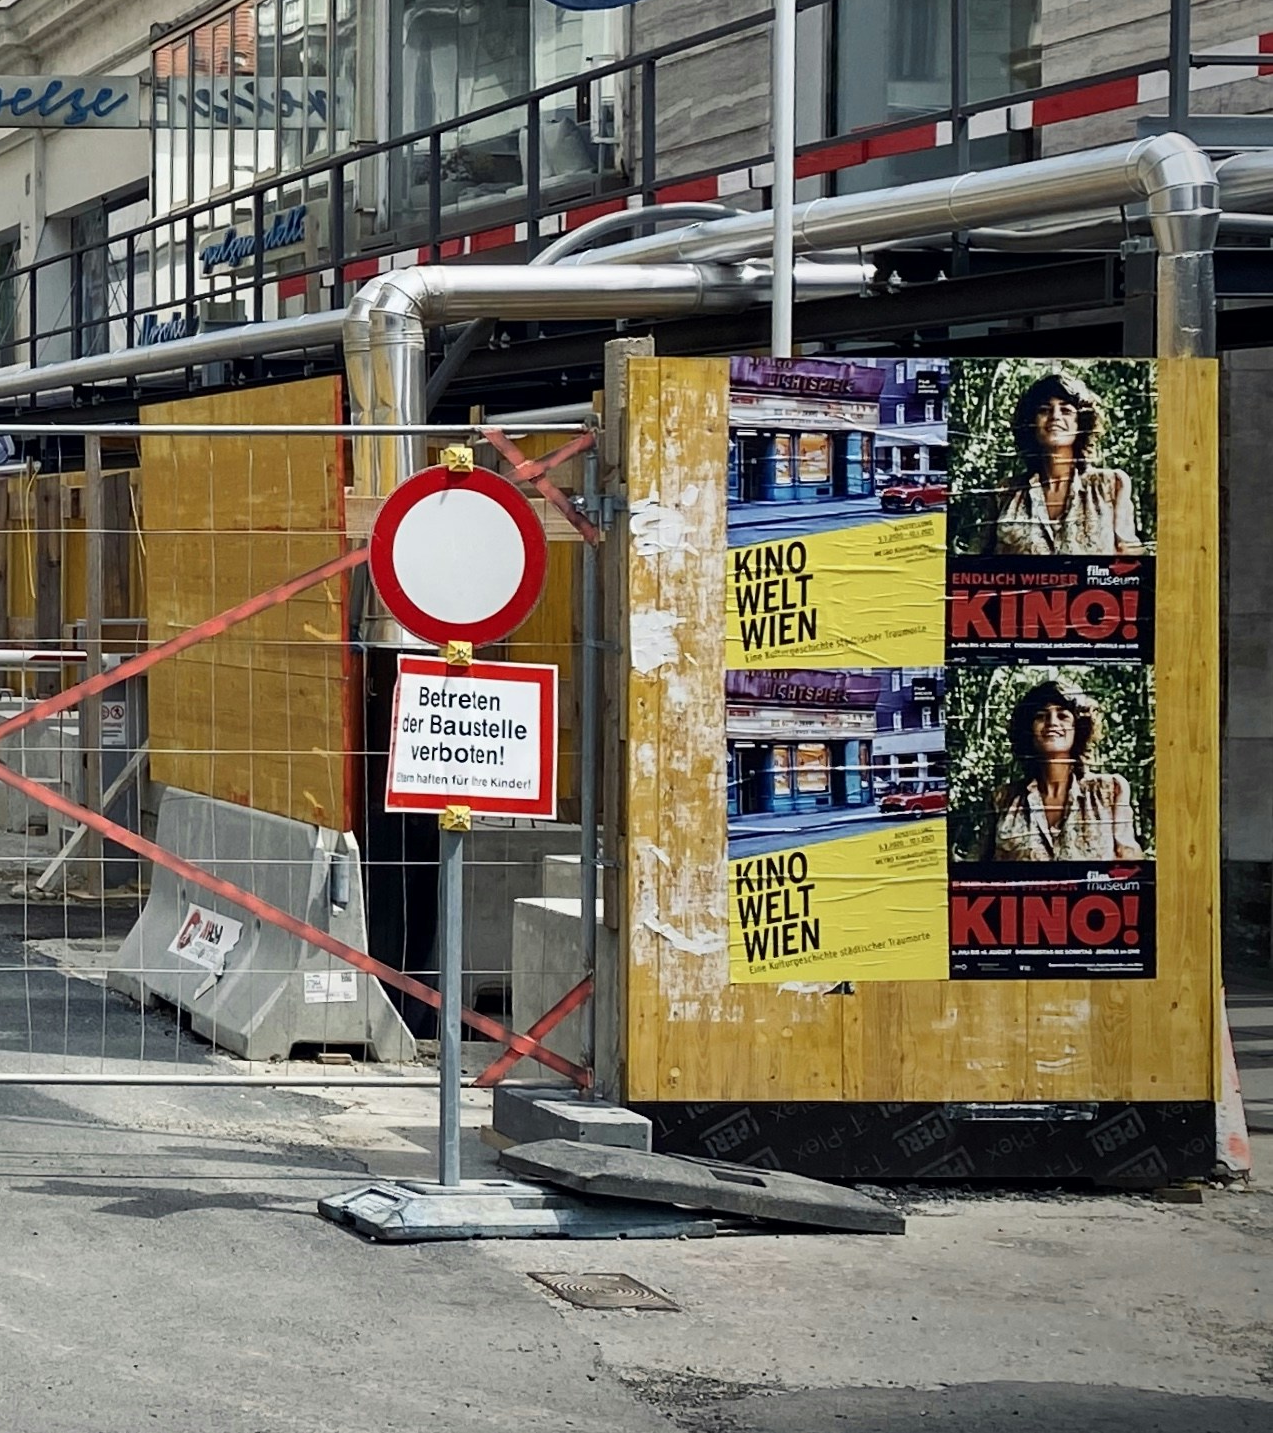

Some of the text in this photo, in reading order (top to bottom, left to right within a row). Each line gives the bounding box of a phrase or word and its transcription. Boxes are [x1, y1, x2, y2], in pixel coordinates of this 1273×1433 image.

[734, 541, 807, 583] KINO
[952, 572, 1079, 586] ENDLICH WIEDER
[1086, 576, 1140, 586] museum
[735, 574, 813, 618] WELT
[951, 588, 1140, 640] KINO!
[740, 608, 817, 652] WIEN
[419, 686, 501, 712] Betreten
[402, 713, 528, 740] der Baustelle
[411, 742, 505, 766] verboten!
[416, 773, 448, 785] haften
[452, 774, 469, 786] für
[490, 777, 531, 790] Kinder!
[735, 851, 808, 895] KINO
[1086, 881, 1140, 891] museum
[737, 883, 816, 929] WELT
[951, 895, 1140, 945] KINO!
[743, 918, 820, 963] WIEN
[749, 962, 766, 974] Eine
[769, 950, 838, 970] Kulturgeschichte
[888, 931, 931, 949] Traumorte
